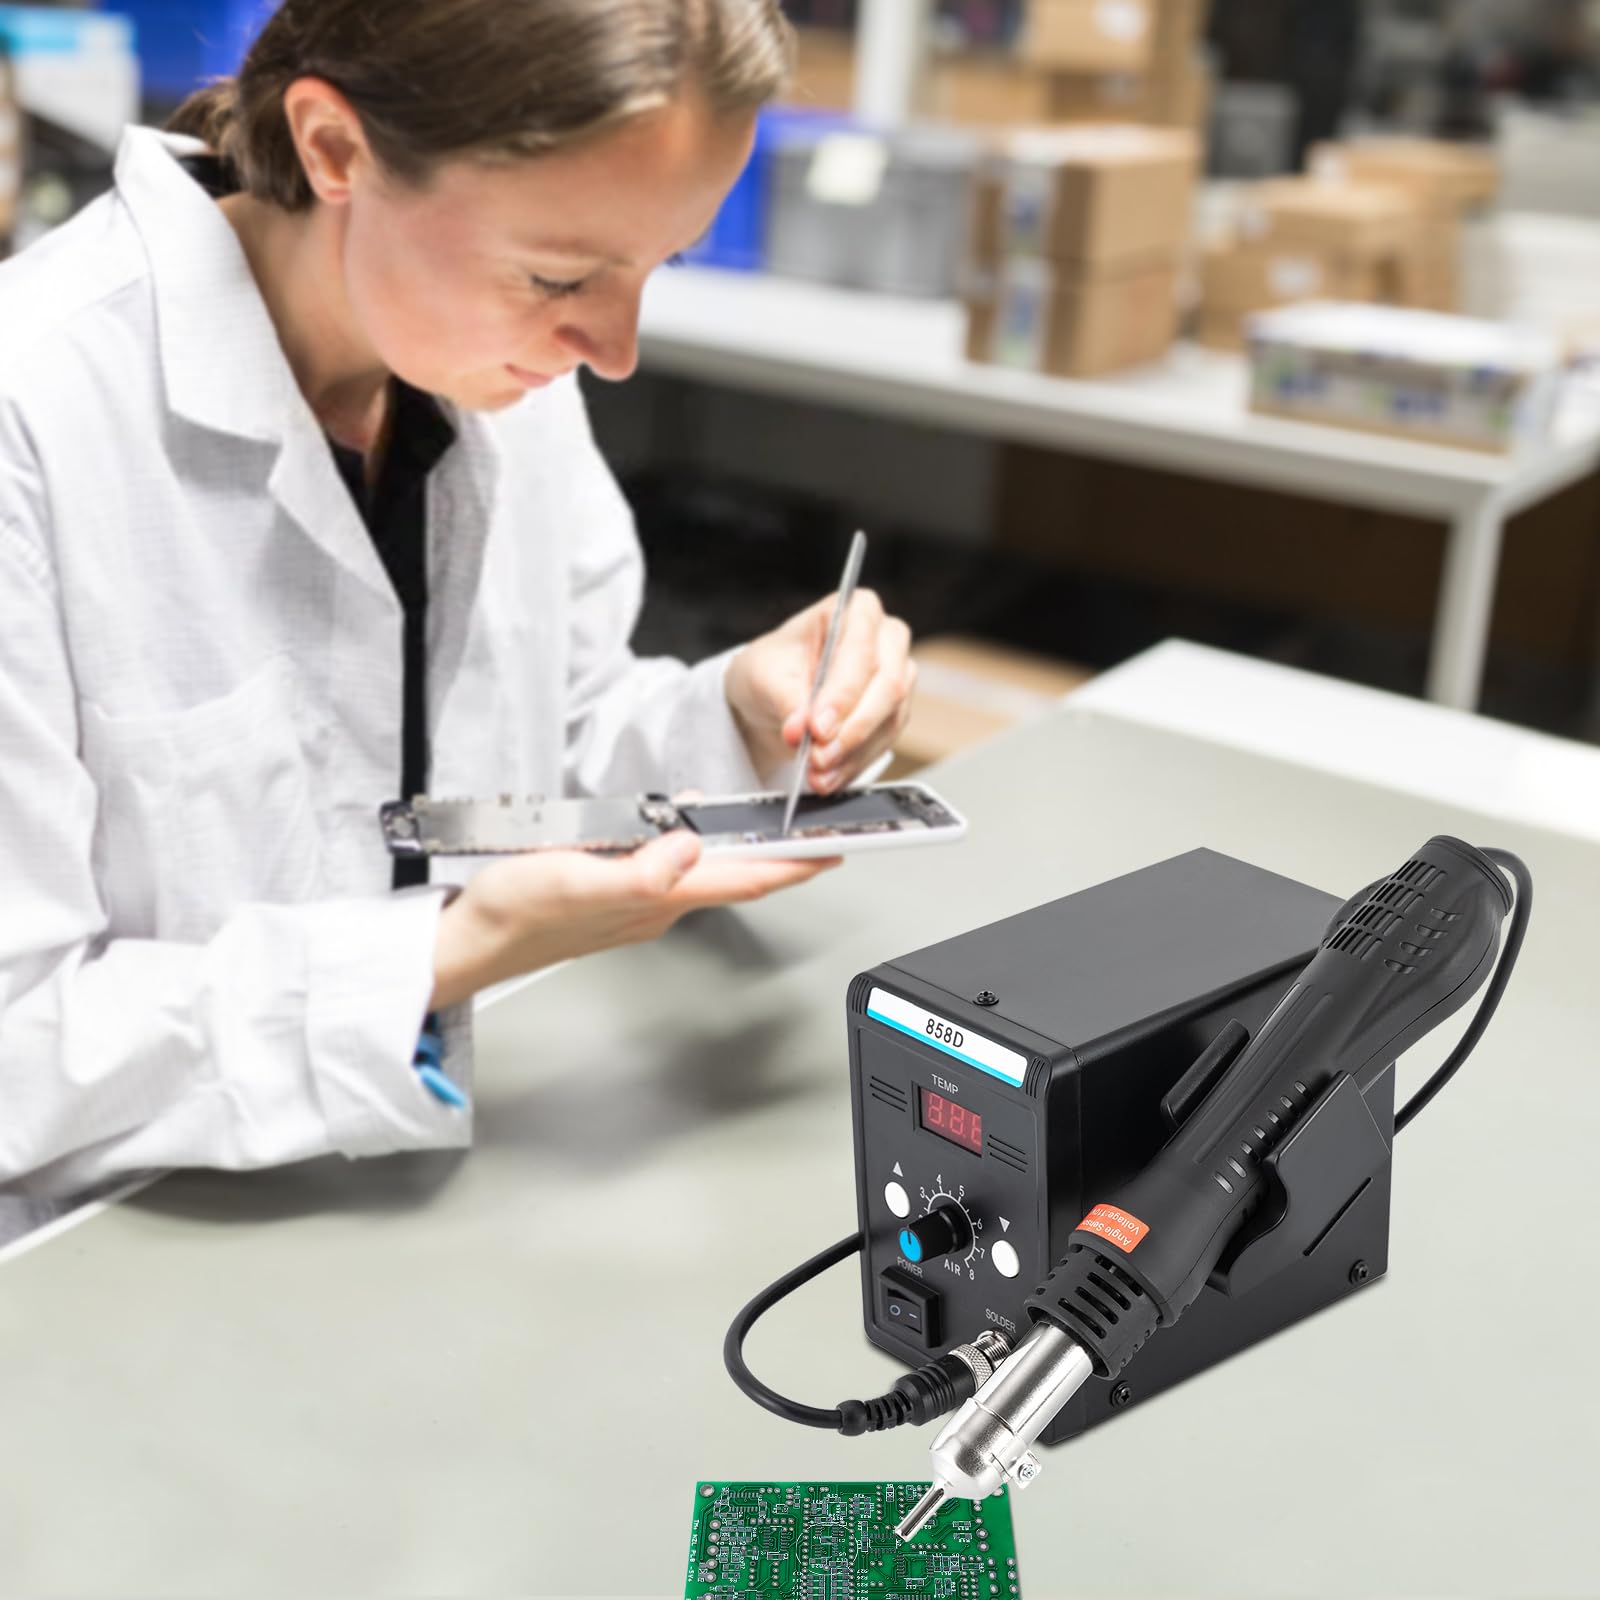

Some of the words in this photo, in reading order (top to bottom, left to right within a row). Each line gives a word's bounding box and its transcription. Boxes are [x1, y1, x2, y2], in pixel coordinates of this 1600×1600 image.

[925, 1018, 964, 1048] 858D
[931, 1073, 959, 1095] TEMP
[936, 1174, 942, 1185] 4
[919, 1186, 925, 1198] 3
[959, 1185, 965, 1197] 5
[977, 1218, 983, 1230] 6
[1104, 1226, 1132, 1246] Angle
[979, 1249, 985, 1259] 7
[897, 1256, 923, 1279] POWER
[943, 1258, 961, 1276] AIR
[969, 1269, 975, 1280] 8
[985, 1308, 1017, 1333] SOLDER
